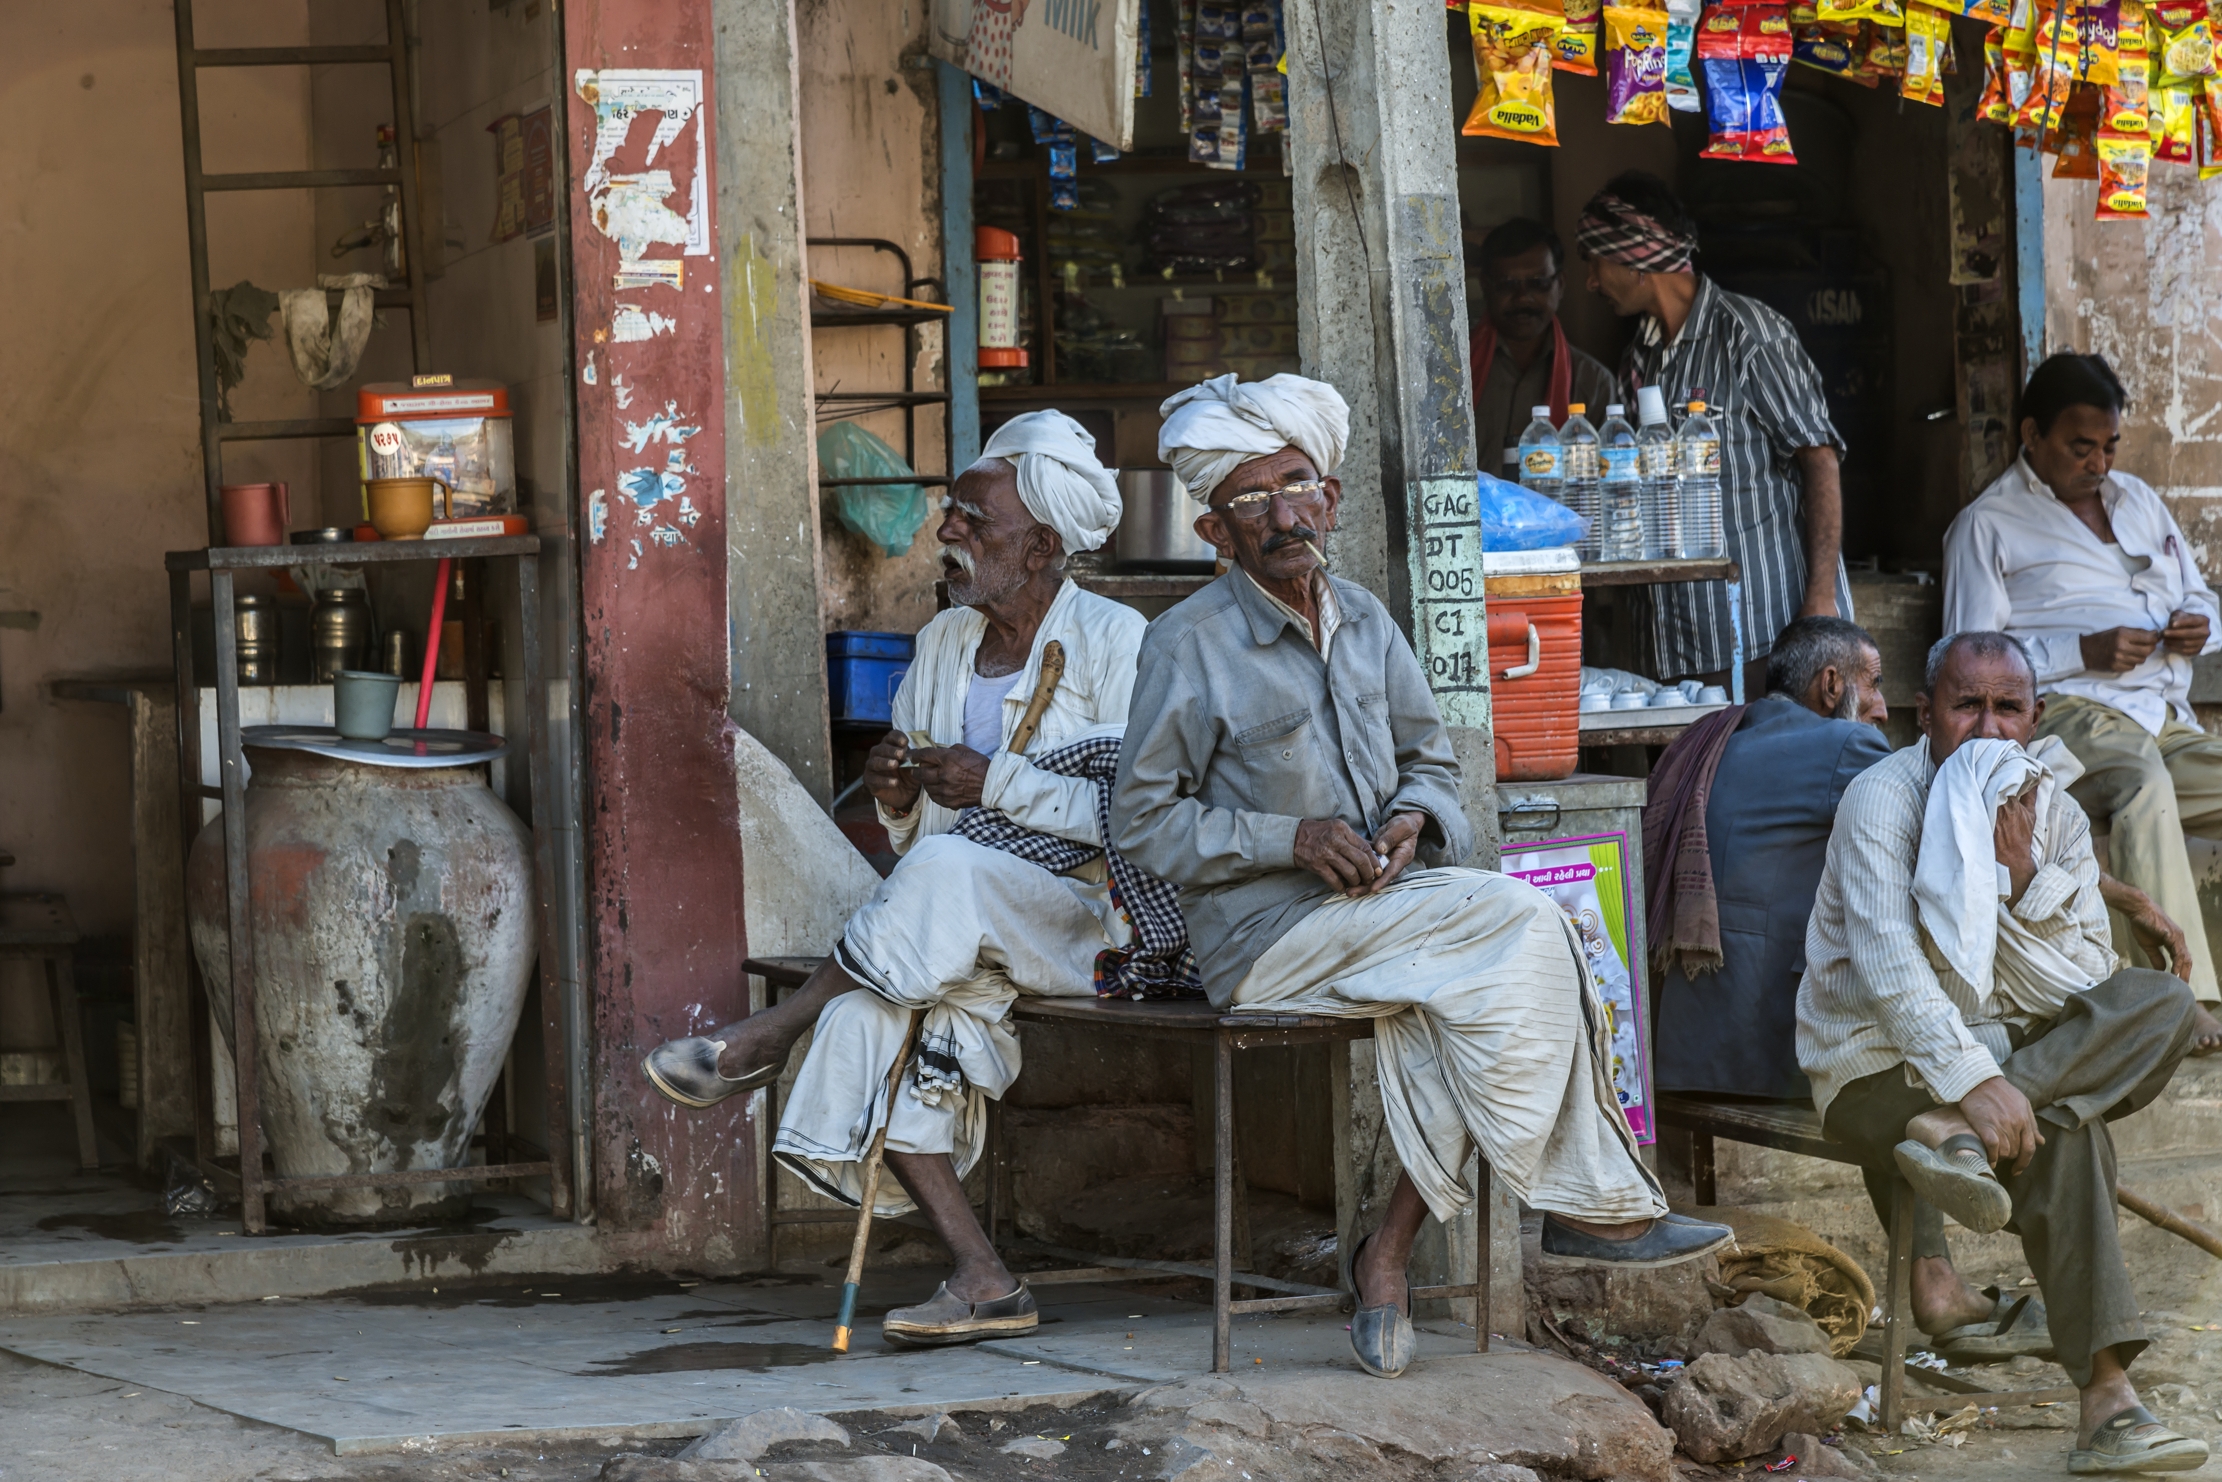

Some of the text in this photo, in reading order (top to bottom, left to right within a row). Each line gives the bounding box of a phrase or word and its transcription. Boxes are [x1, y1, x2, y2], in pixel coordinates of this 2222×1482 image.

[1497, 111, 1540, 127] Vadalia
[2116, 119, 2144, 128] Vadalia
[2113, 199, 2143, 209] Vadalia
[1423, 493, 1472, 517] GAG
[1425, 533, 1463, 558] DT
[1428, 568, 1474, 597] 005
